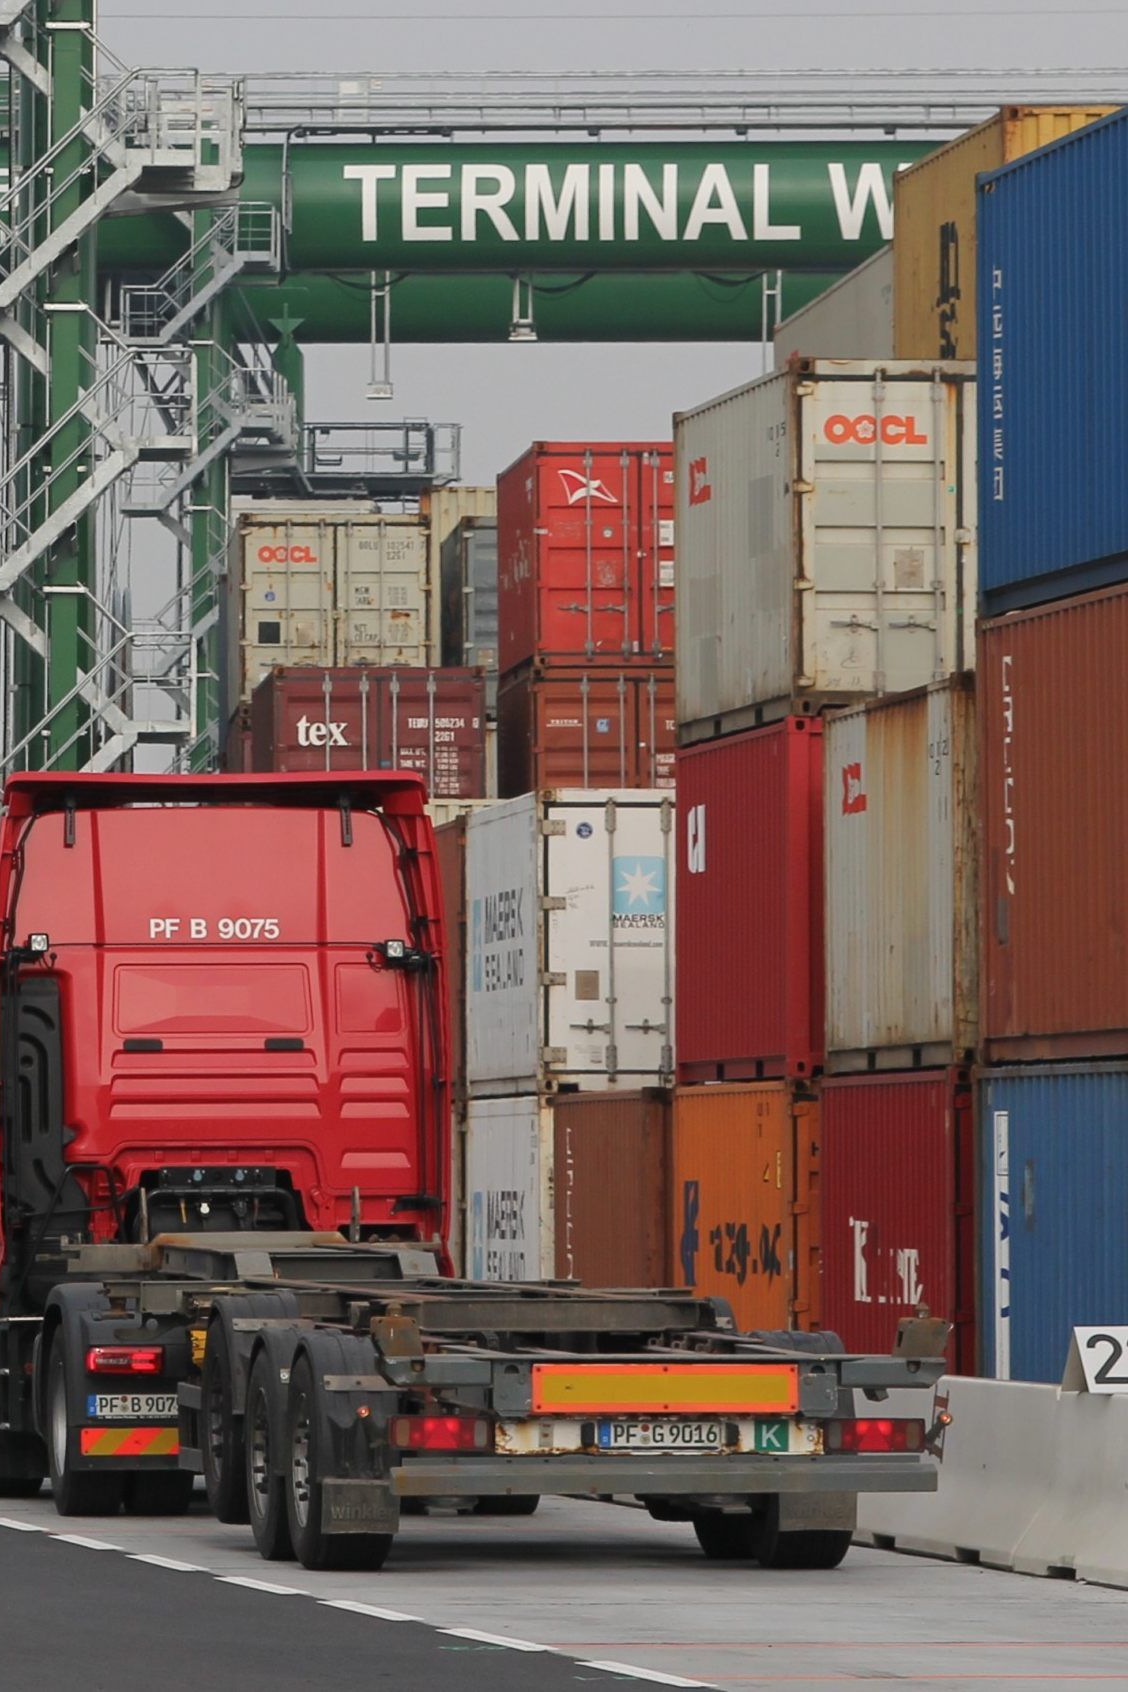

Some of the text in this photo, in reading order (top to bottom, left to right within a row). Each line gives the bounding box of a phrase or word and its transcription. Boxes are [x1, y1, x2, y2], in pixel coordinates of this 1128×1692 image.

[343, 163, 802, 241] TERMINAL
[824, 414, 928, 445] OOCL
[258, 546, 318, 563] OOCL
[296, 715, 349, 747] tex
[149, 918, 280, 938] PF B 9075
[613, 914, 664, 922] MAERSK
[1086, 1333, 1128, 1385] 2
[99, 1397, 179, 1414] PF B 907
[612, 1424, 718, 1444] PF G 9016
[761, 1423, 781, 1449] K
